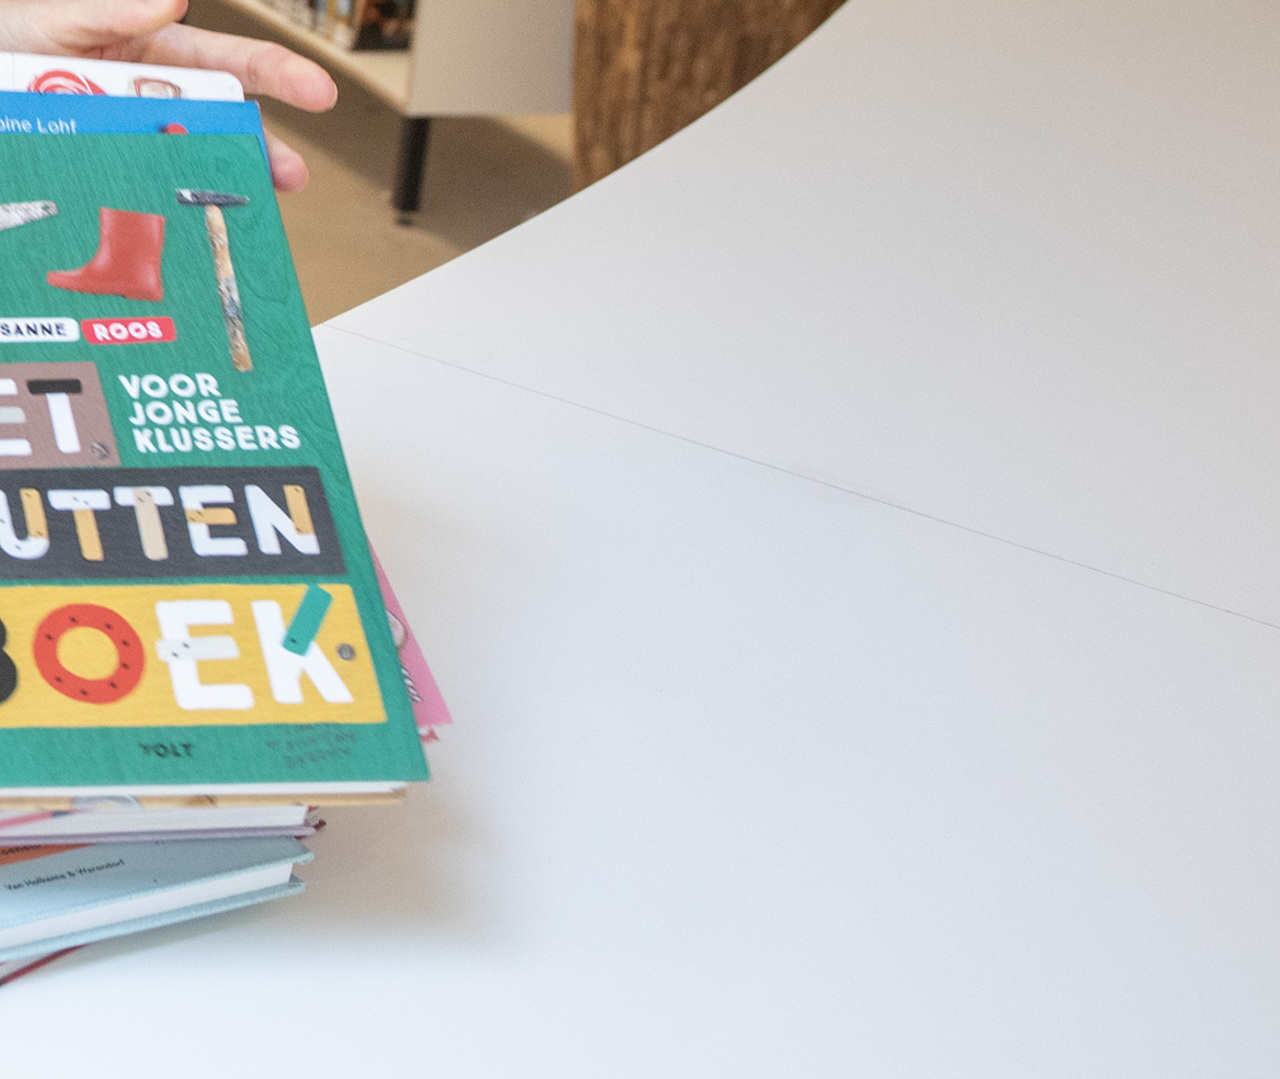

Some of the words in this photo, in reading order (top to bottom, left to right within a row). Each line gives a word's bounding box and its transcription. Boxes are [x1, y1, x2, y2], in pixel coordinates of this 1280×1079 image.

[92, 320, 163, 342] ROOS
[117, 372, 222, 400] VOOR
[128, 398, 244, 426] JONGE
[132, 424, 302, 454] KLUSSERS
